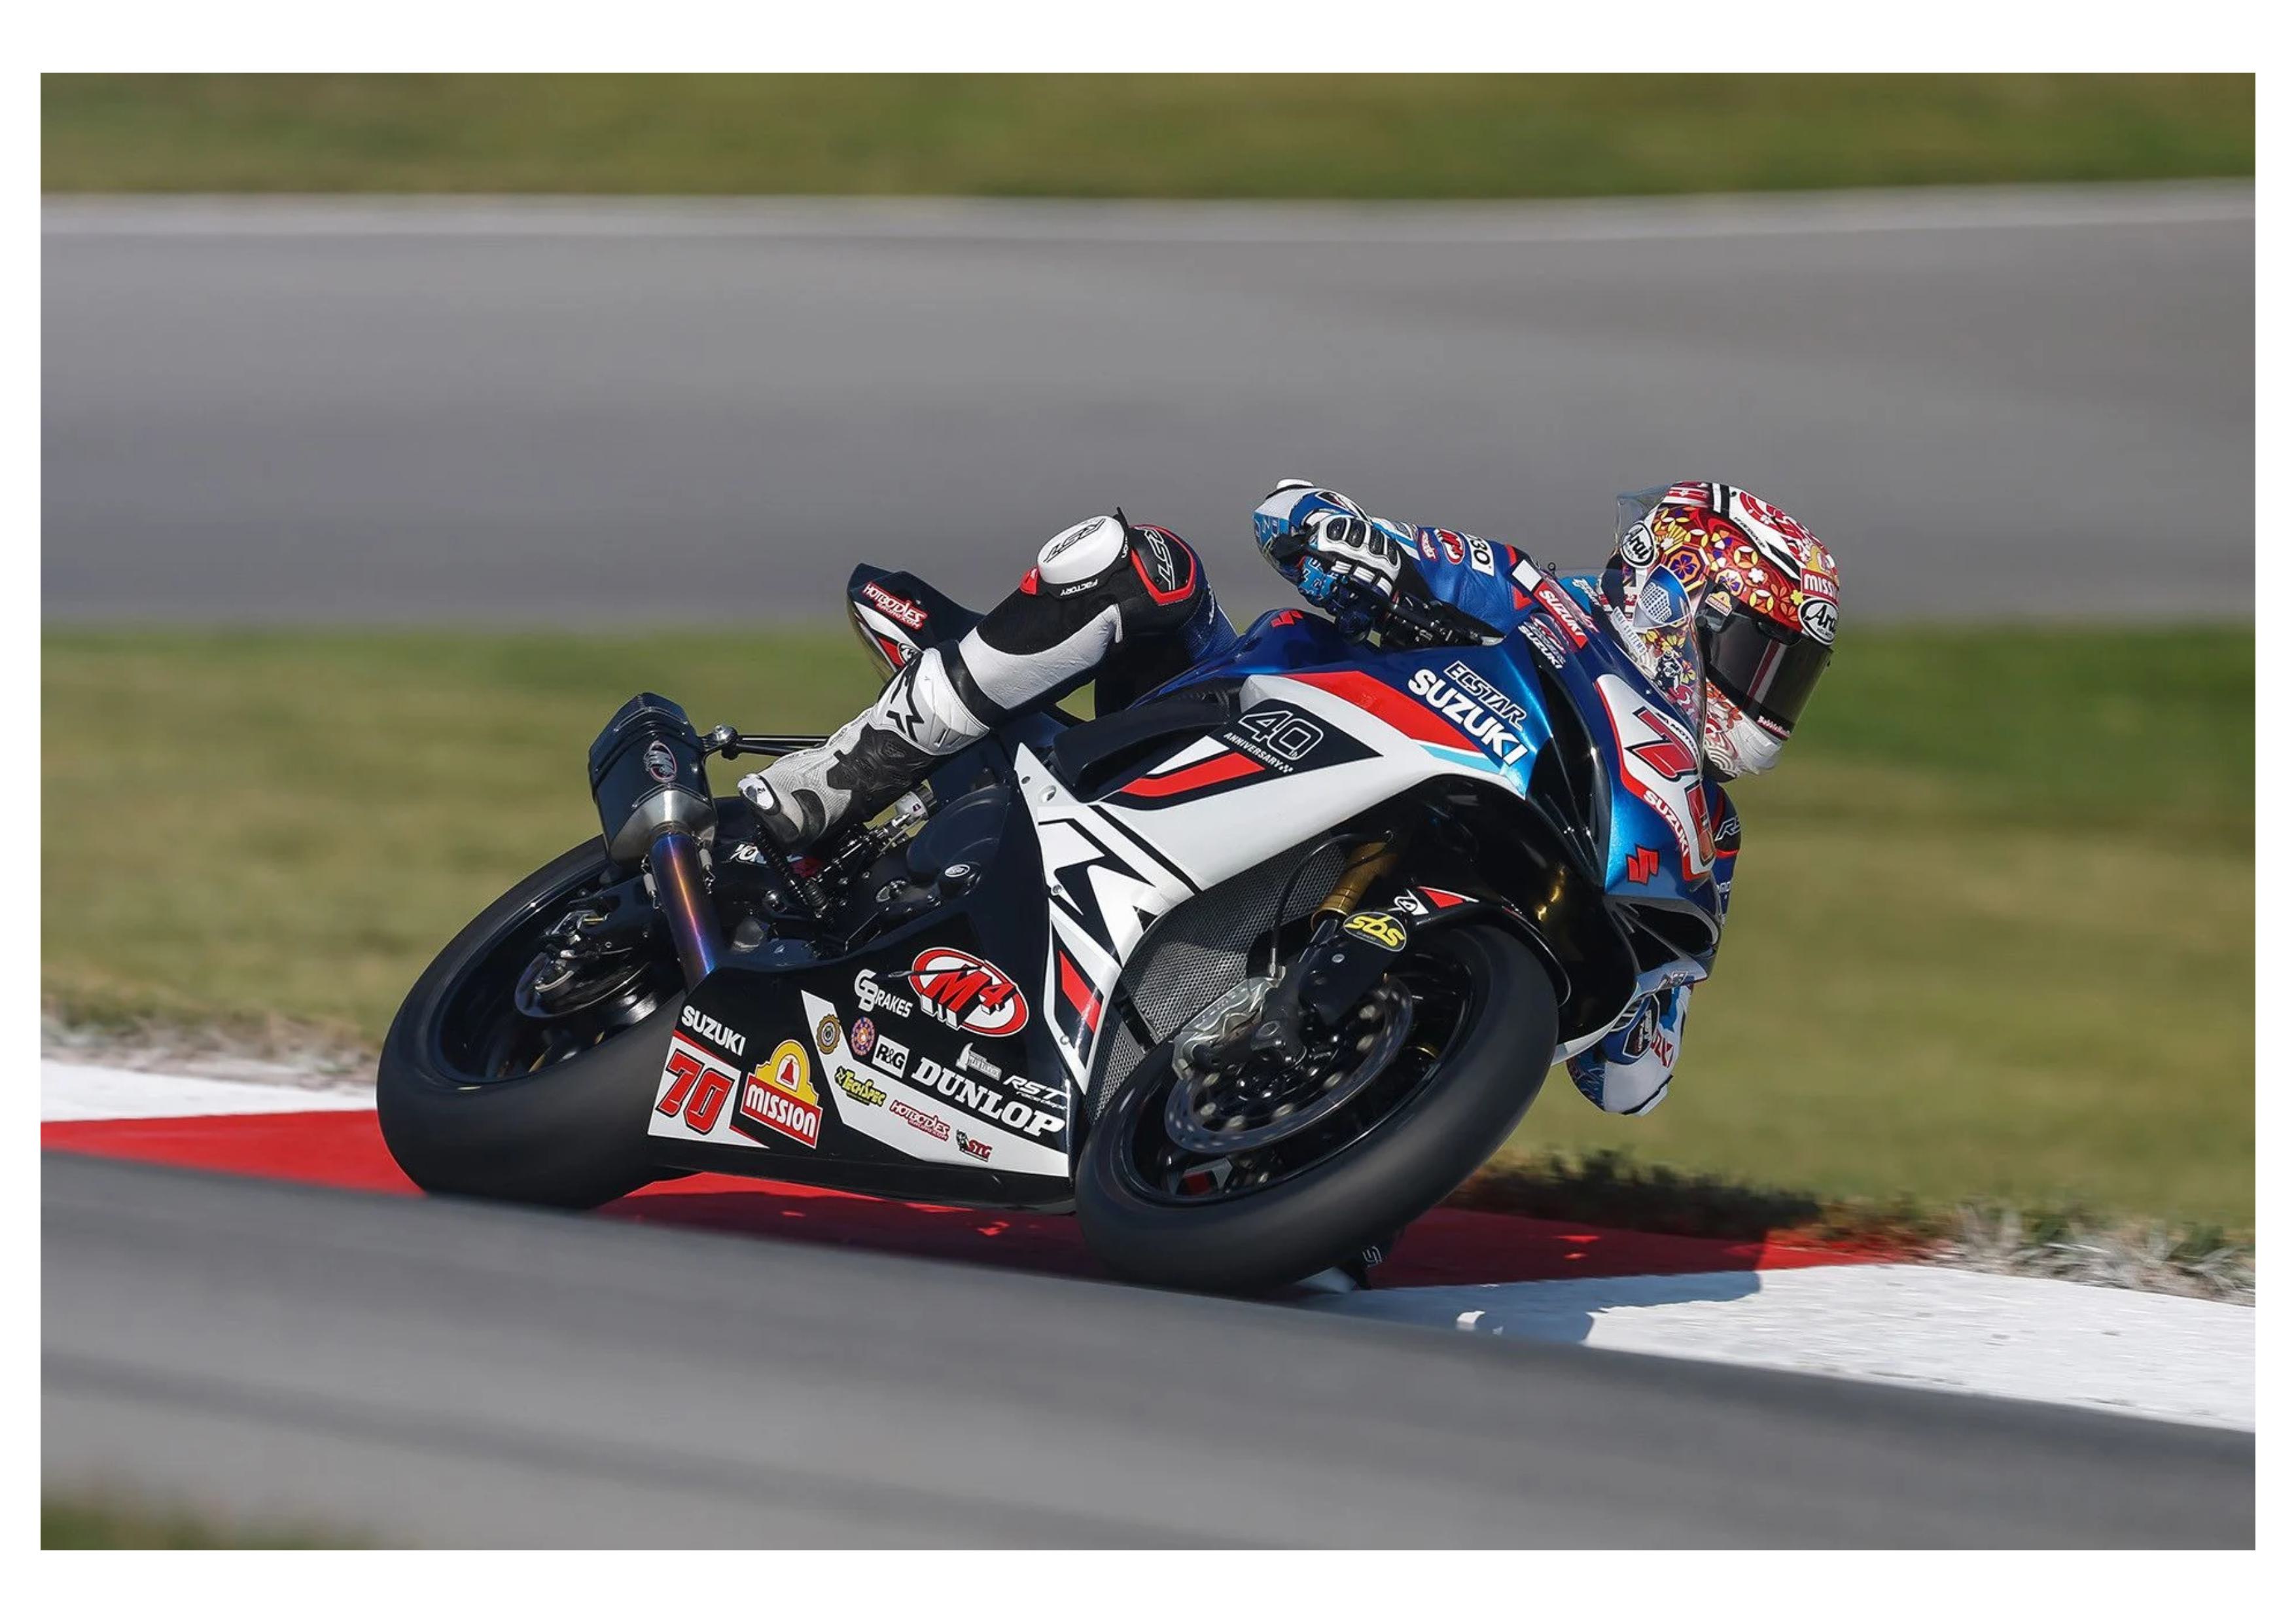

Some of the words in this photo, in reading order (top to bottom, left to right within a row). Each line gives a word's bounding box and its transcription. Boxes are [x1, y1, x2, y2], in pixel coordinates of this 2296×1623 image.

[1144, 526, 1175, 591] RST
[1060, 579, 1099, 596] FACTORY
[1539, 590, 1587, 637] SUZUKI
[1517, 624, 1563, 669] SUZUKI
[1408, 669, 1528, 767] SUZUKI
[1443, 660, 1527, 731] ECSTAR
[1223, 732, 1283, 768] ANNIVERSARY
[1643, 790, 1689, 857] SUZUKI
[921, 969, 1016, 1029] M4
[681, 1005, 747, 1057] SUZUKI
[875, 1043, 905, 1070] R&G
[655, 1048, 735, 1135] 70
[745, 1083, 817, 1139] MISSION
[911, 1057, 1066, 1137] DUNLOP
[1002, 1075, 1069, 1100] RST
[891, 1101, 950, 1137] HOTBODIES
